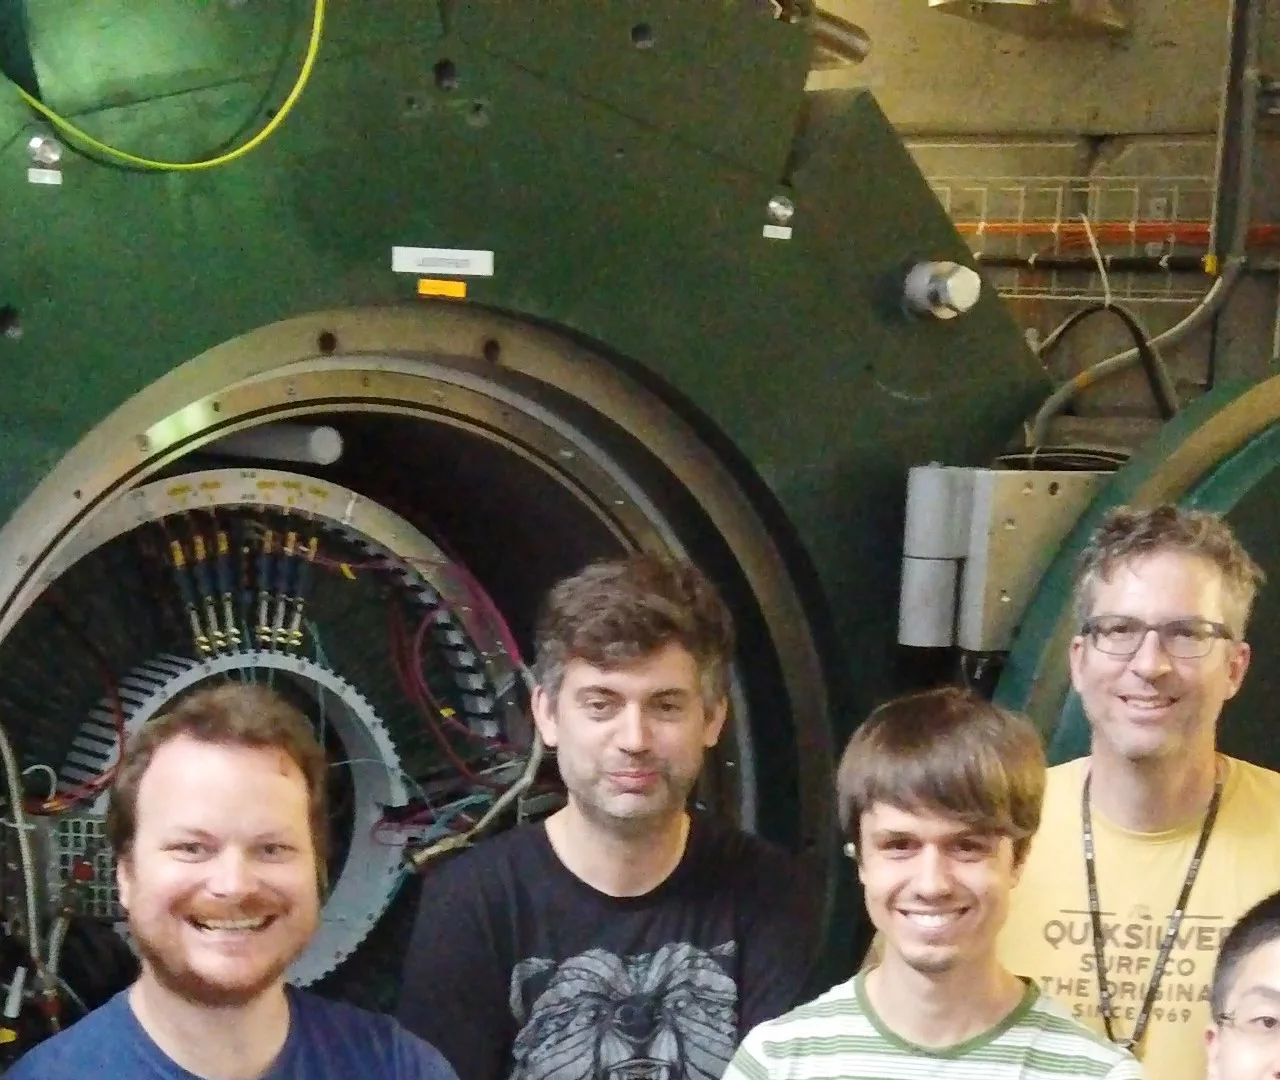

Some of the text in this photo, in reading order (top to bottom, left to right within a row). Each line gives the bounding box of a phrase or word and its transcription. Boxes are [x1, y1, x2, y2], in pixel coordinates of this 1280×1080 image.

[1044, 919, 1232, 951] QUKSILVE
[1079, 953, 1196, 977] SURF CO
[1040, 976, 1213, 1002] THE ORIINA
[1152, 1007, 1193, 1023] 969
